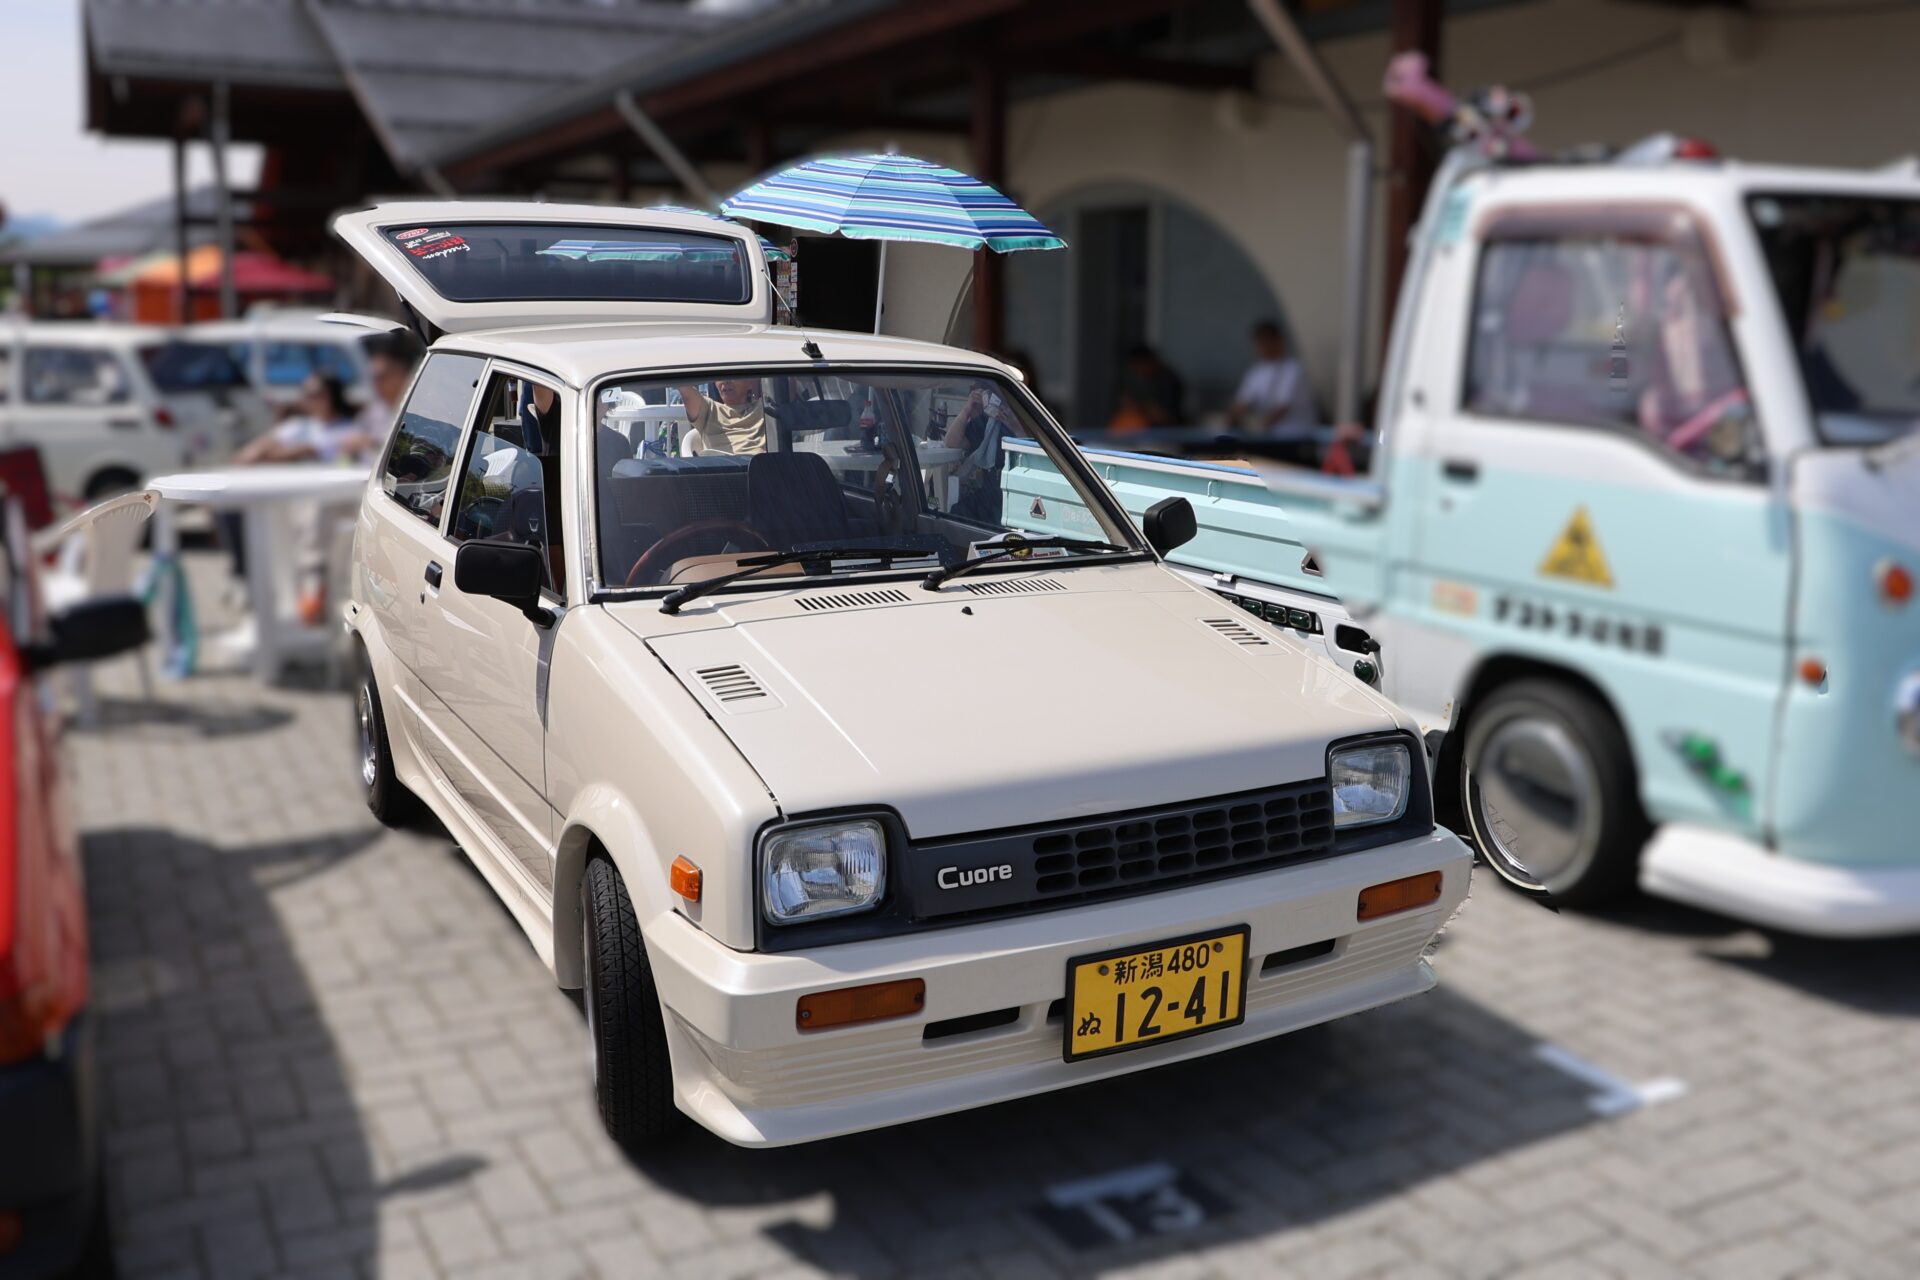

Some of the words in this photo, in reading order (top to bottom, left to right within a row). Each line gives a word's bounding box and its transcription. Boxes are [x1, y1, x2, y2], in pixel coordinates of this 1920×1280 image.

[422, 243, 471, 260] Freedom
[937, 864, 1013, 890] Cuore
[1077, 1012, 1101, 1037] ぬ
[1115, 970, 1230, 1043] 12-41
